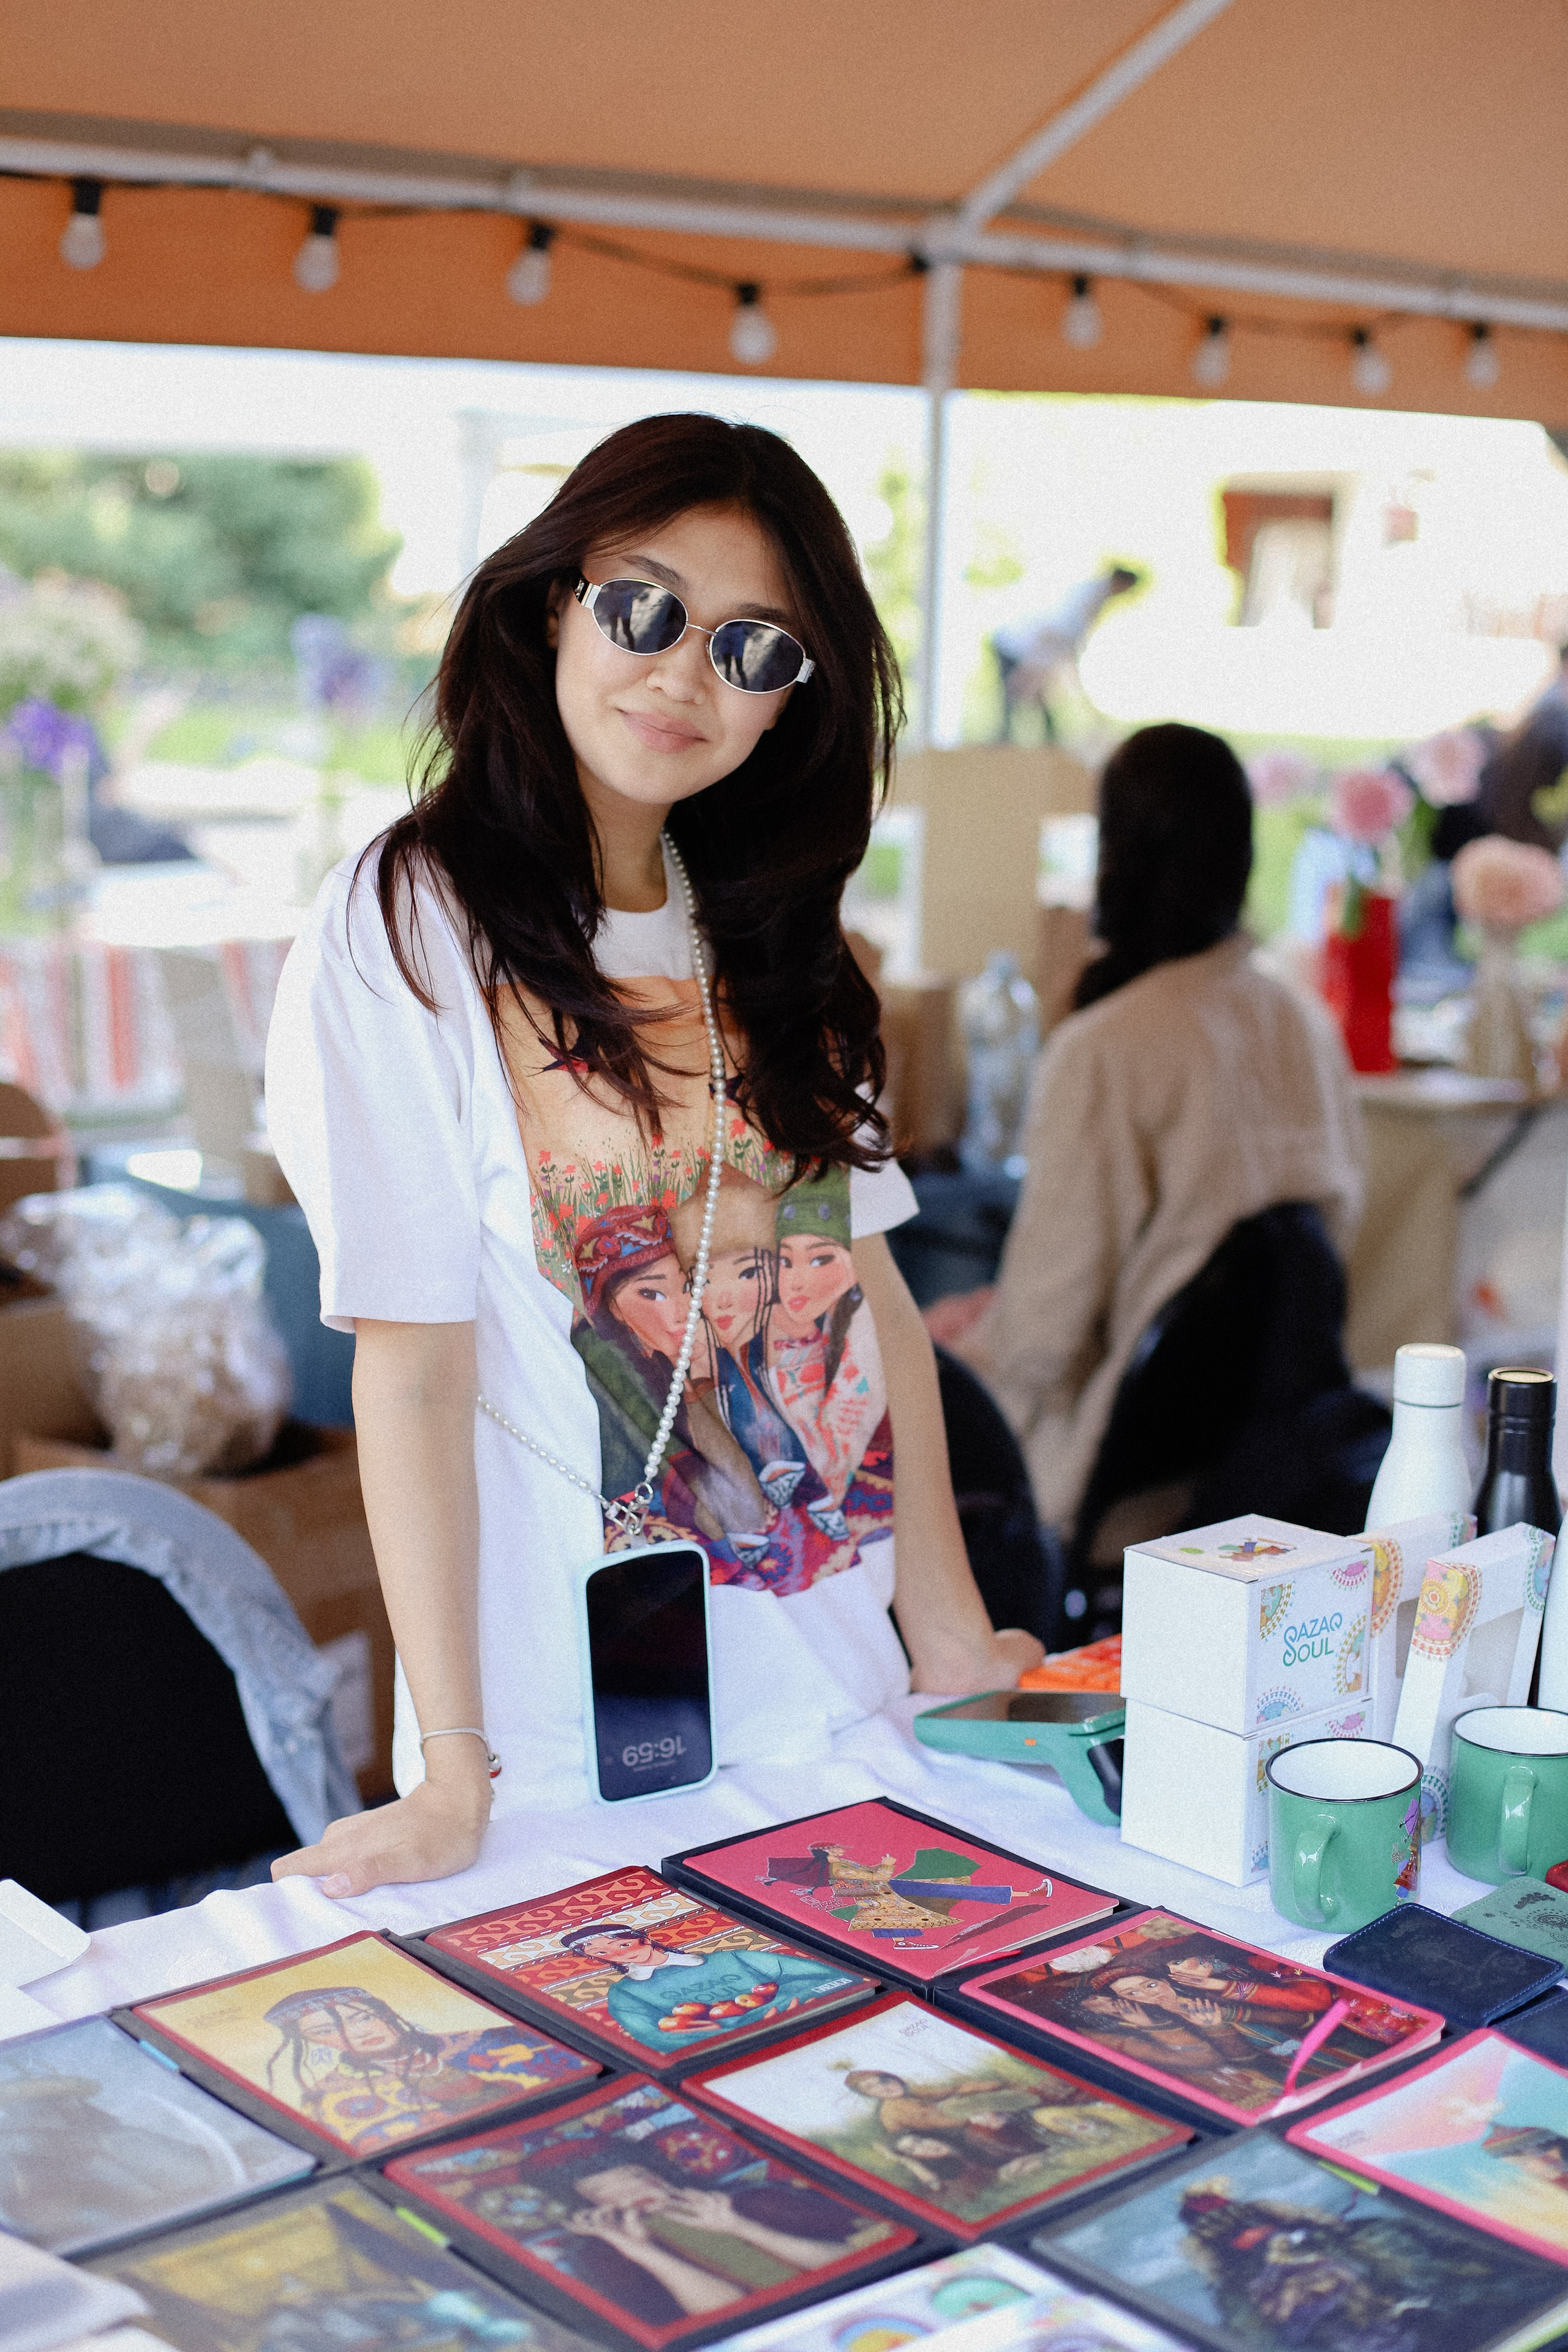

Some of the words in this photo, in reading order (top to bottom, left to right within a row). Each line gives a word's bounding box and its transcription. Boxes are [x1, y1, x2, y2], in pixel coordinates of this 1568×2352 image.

[1284, 1612, 1343, 1644] QAZAQ
[1283, 1637, 1335, 1667] SOUL
[622, 1736, 687, 1767] 16:59
[659, 1974, 742, 2000] QAZAQ
